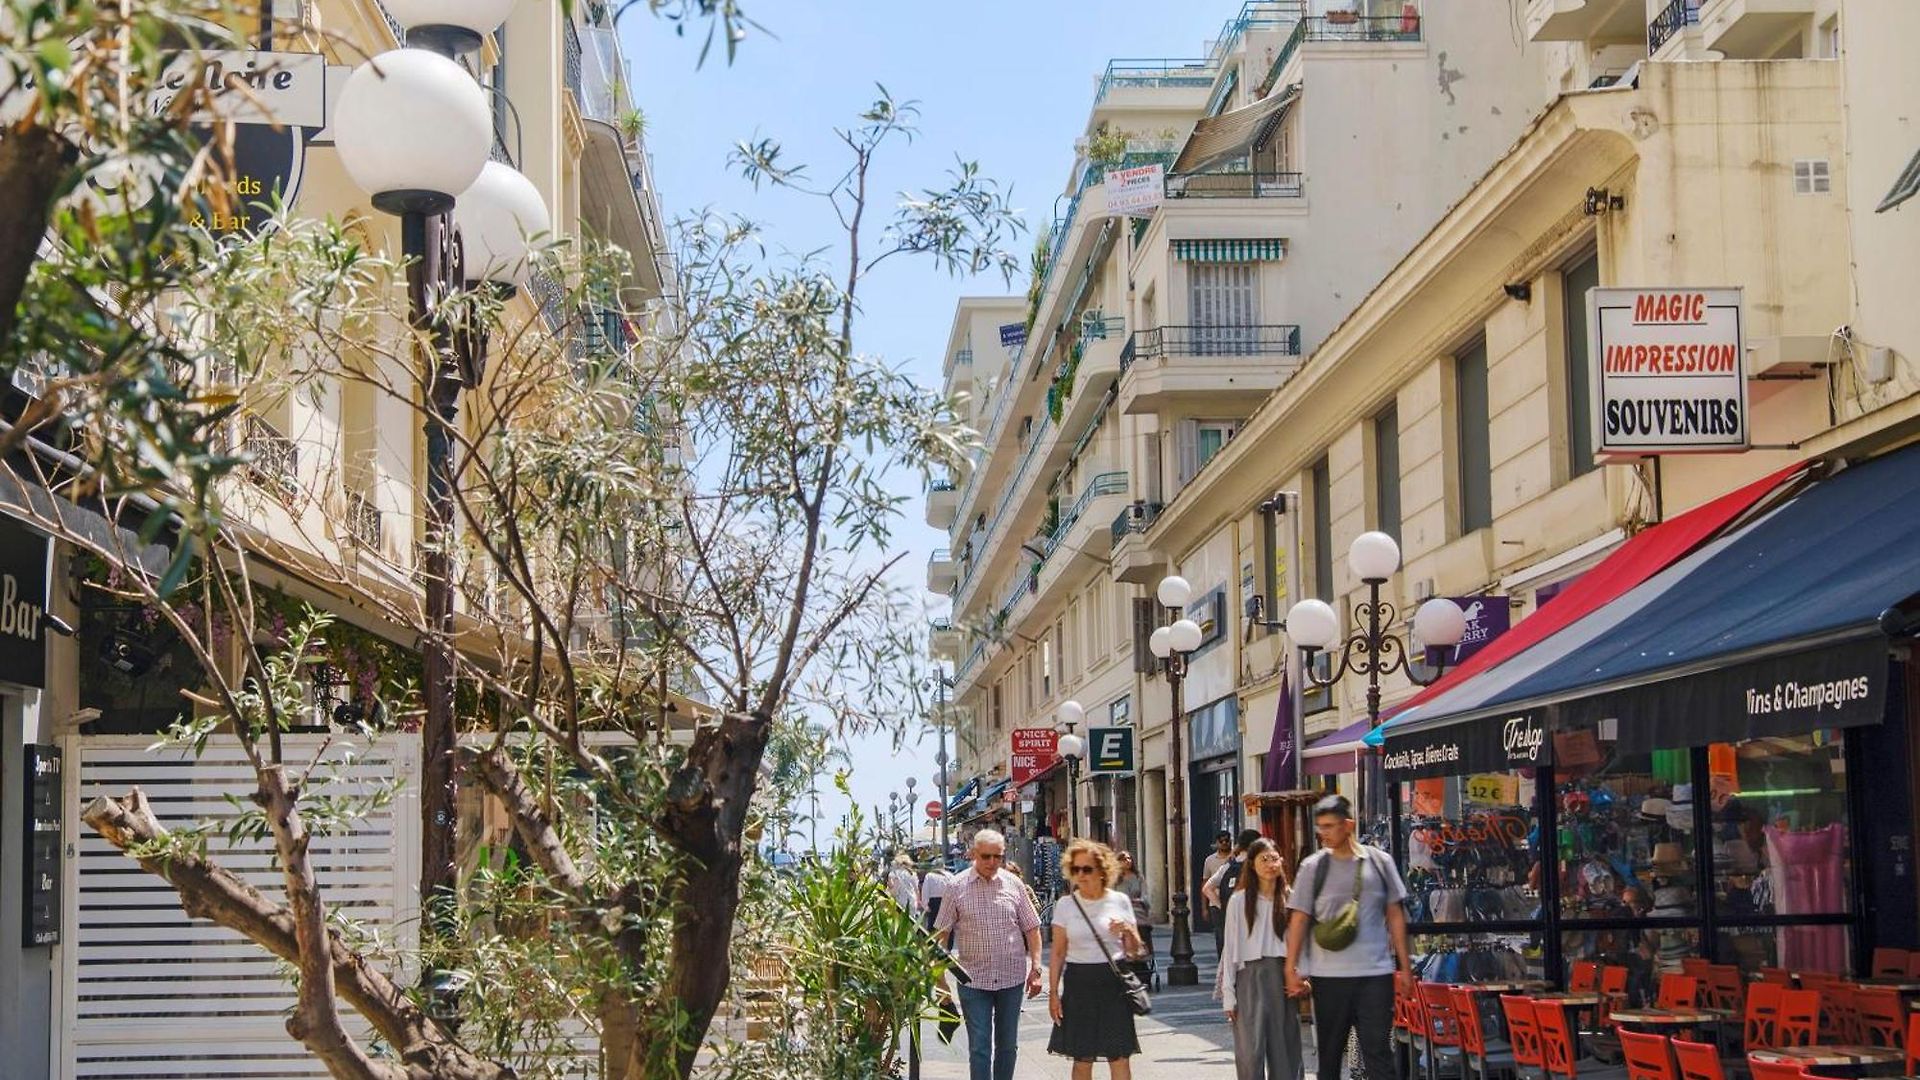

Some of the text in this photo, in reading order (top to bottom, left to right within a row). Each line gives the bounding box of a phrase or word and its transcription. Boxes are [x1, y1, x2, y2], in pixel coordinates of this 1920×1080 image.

[1634, 294, 1704, 322] MAGIC
[1606, 343, 1735, 374] IMPRESSION
[1606, 398, 1739, 436] SOUVENIRS
[1, 574, 42, 640] Bar
[1463, 627, 1488, 641] RRY
[1746, 676, 1868, 714] Vins & Champagnes
[1018, 739, 1052, 748] SPIRIT
[1023, 730, 1047, 739] NICE
[1100, 733, 1123, 758] E
[1013, 756, 1036, 768] NICE
[1472, 786, 1500, 800] 12 €
